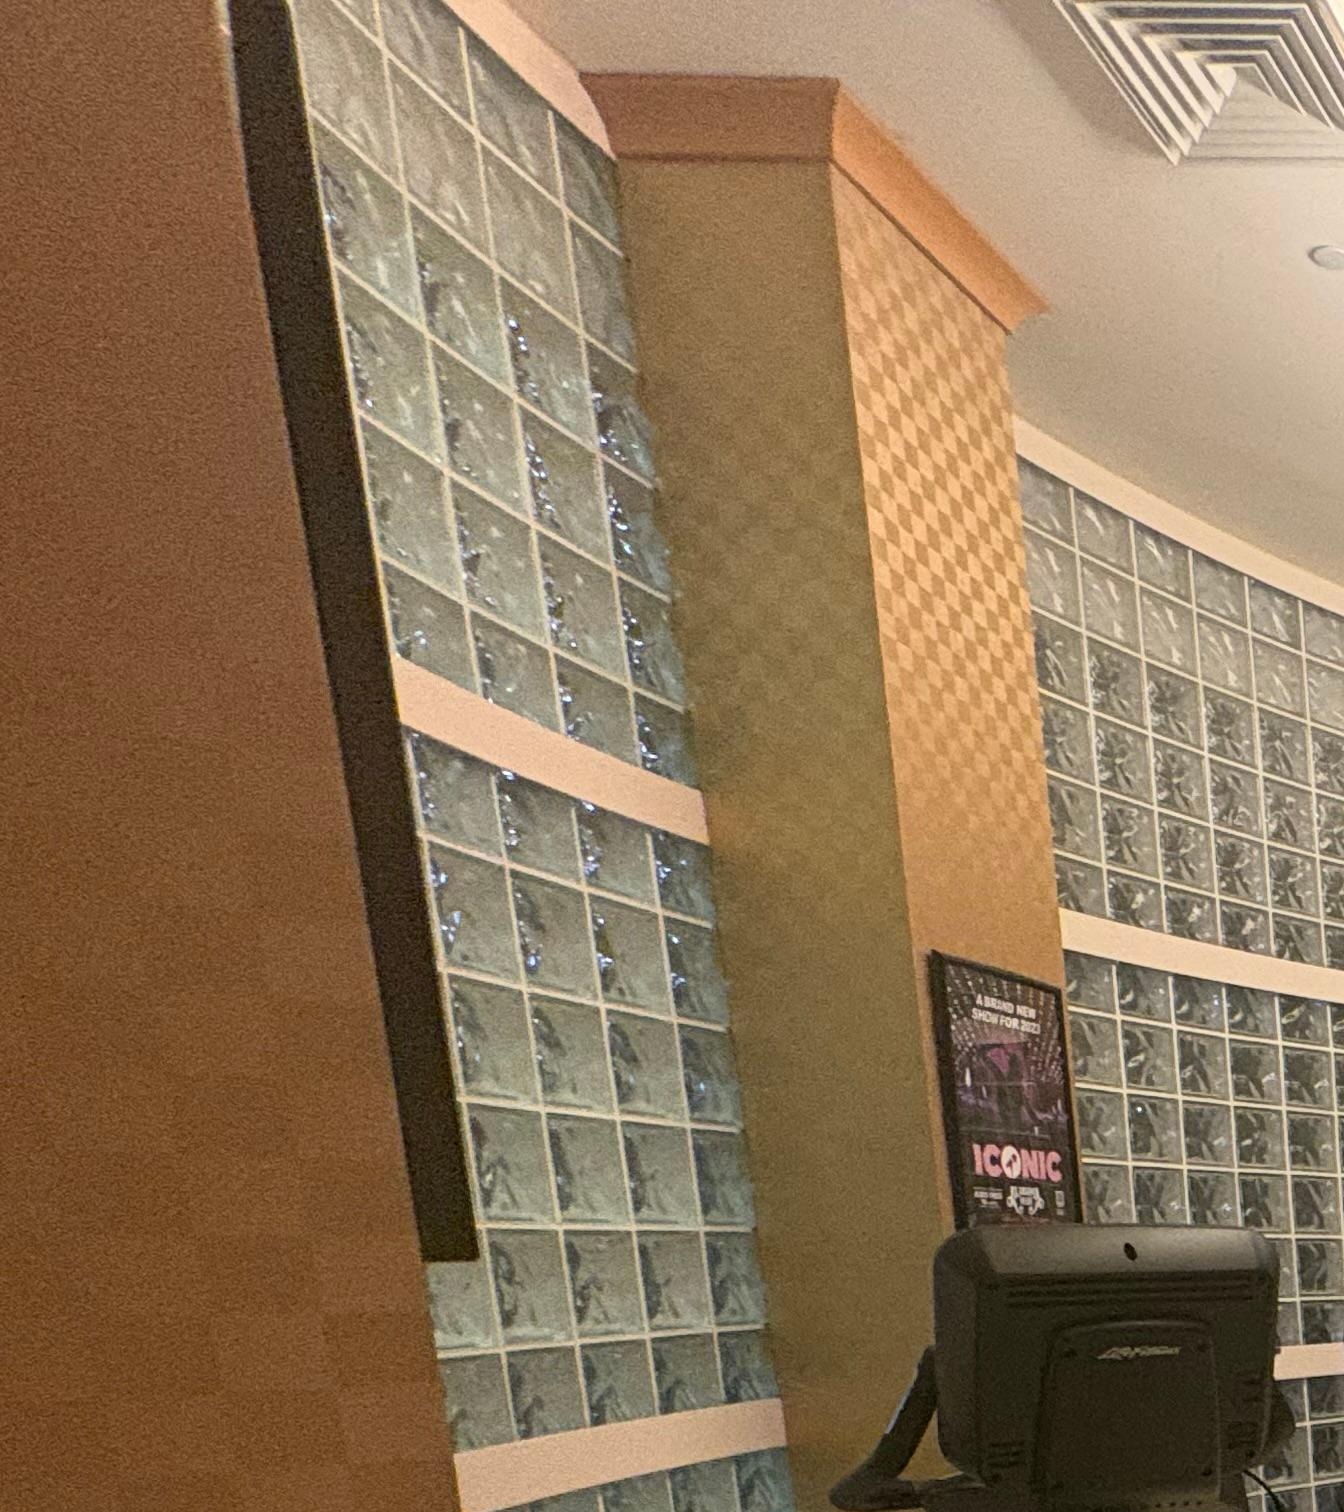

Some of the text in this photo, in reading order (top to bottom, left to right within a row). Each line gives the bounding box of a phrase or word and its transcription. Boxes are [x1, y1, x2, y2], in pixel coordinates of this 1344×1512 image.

[971, 1008, 999, 1024] SHOW
[1000, 1015, 1019, 1030] FOR
[1016, 1005, 1036, 1019] NEW
[972, 1143, 1063, 1183] ICONIC
